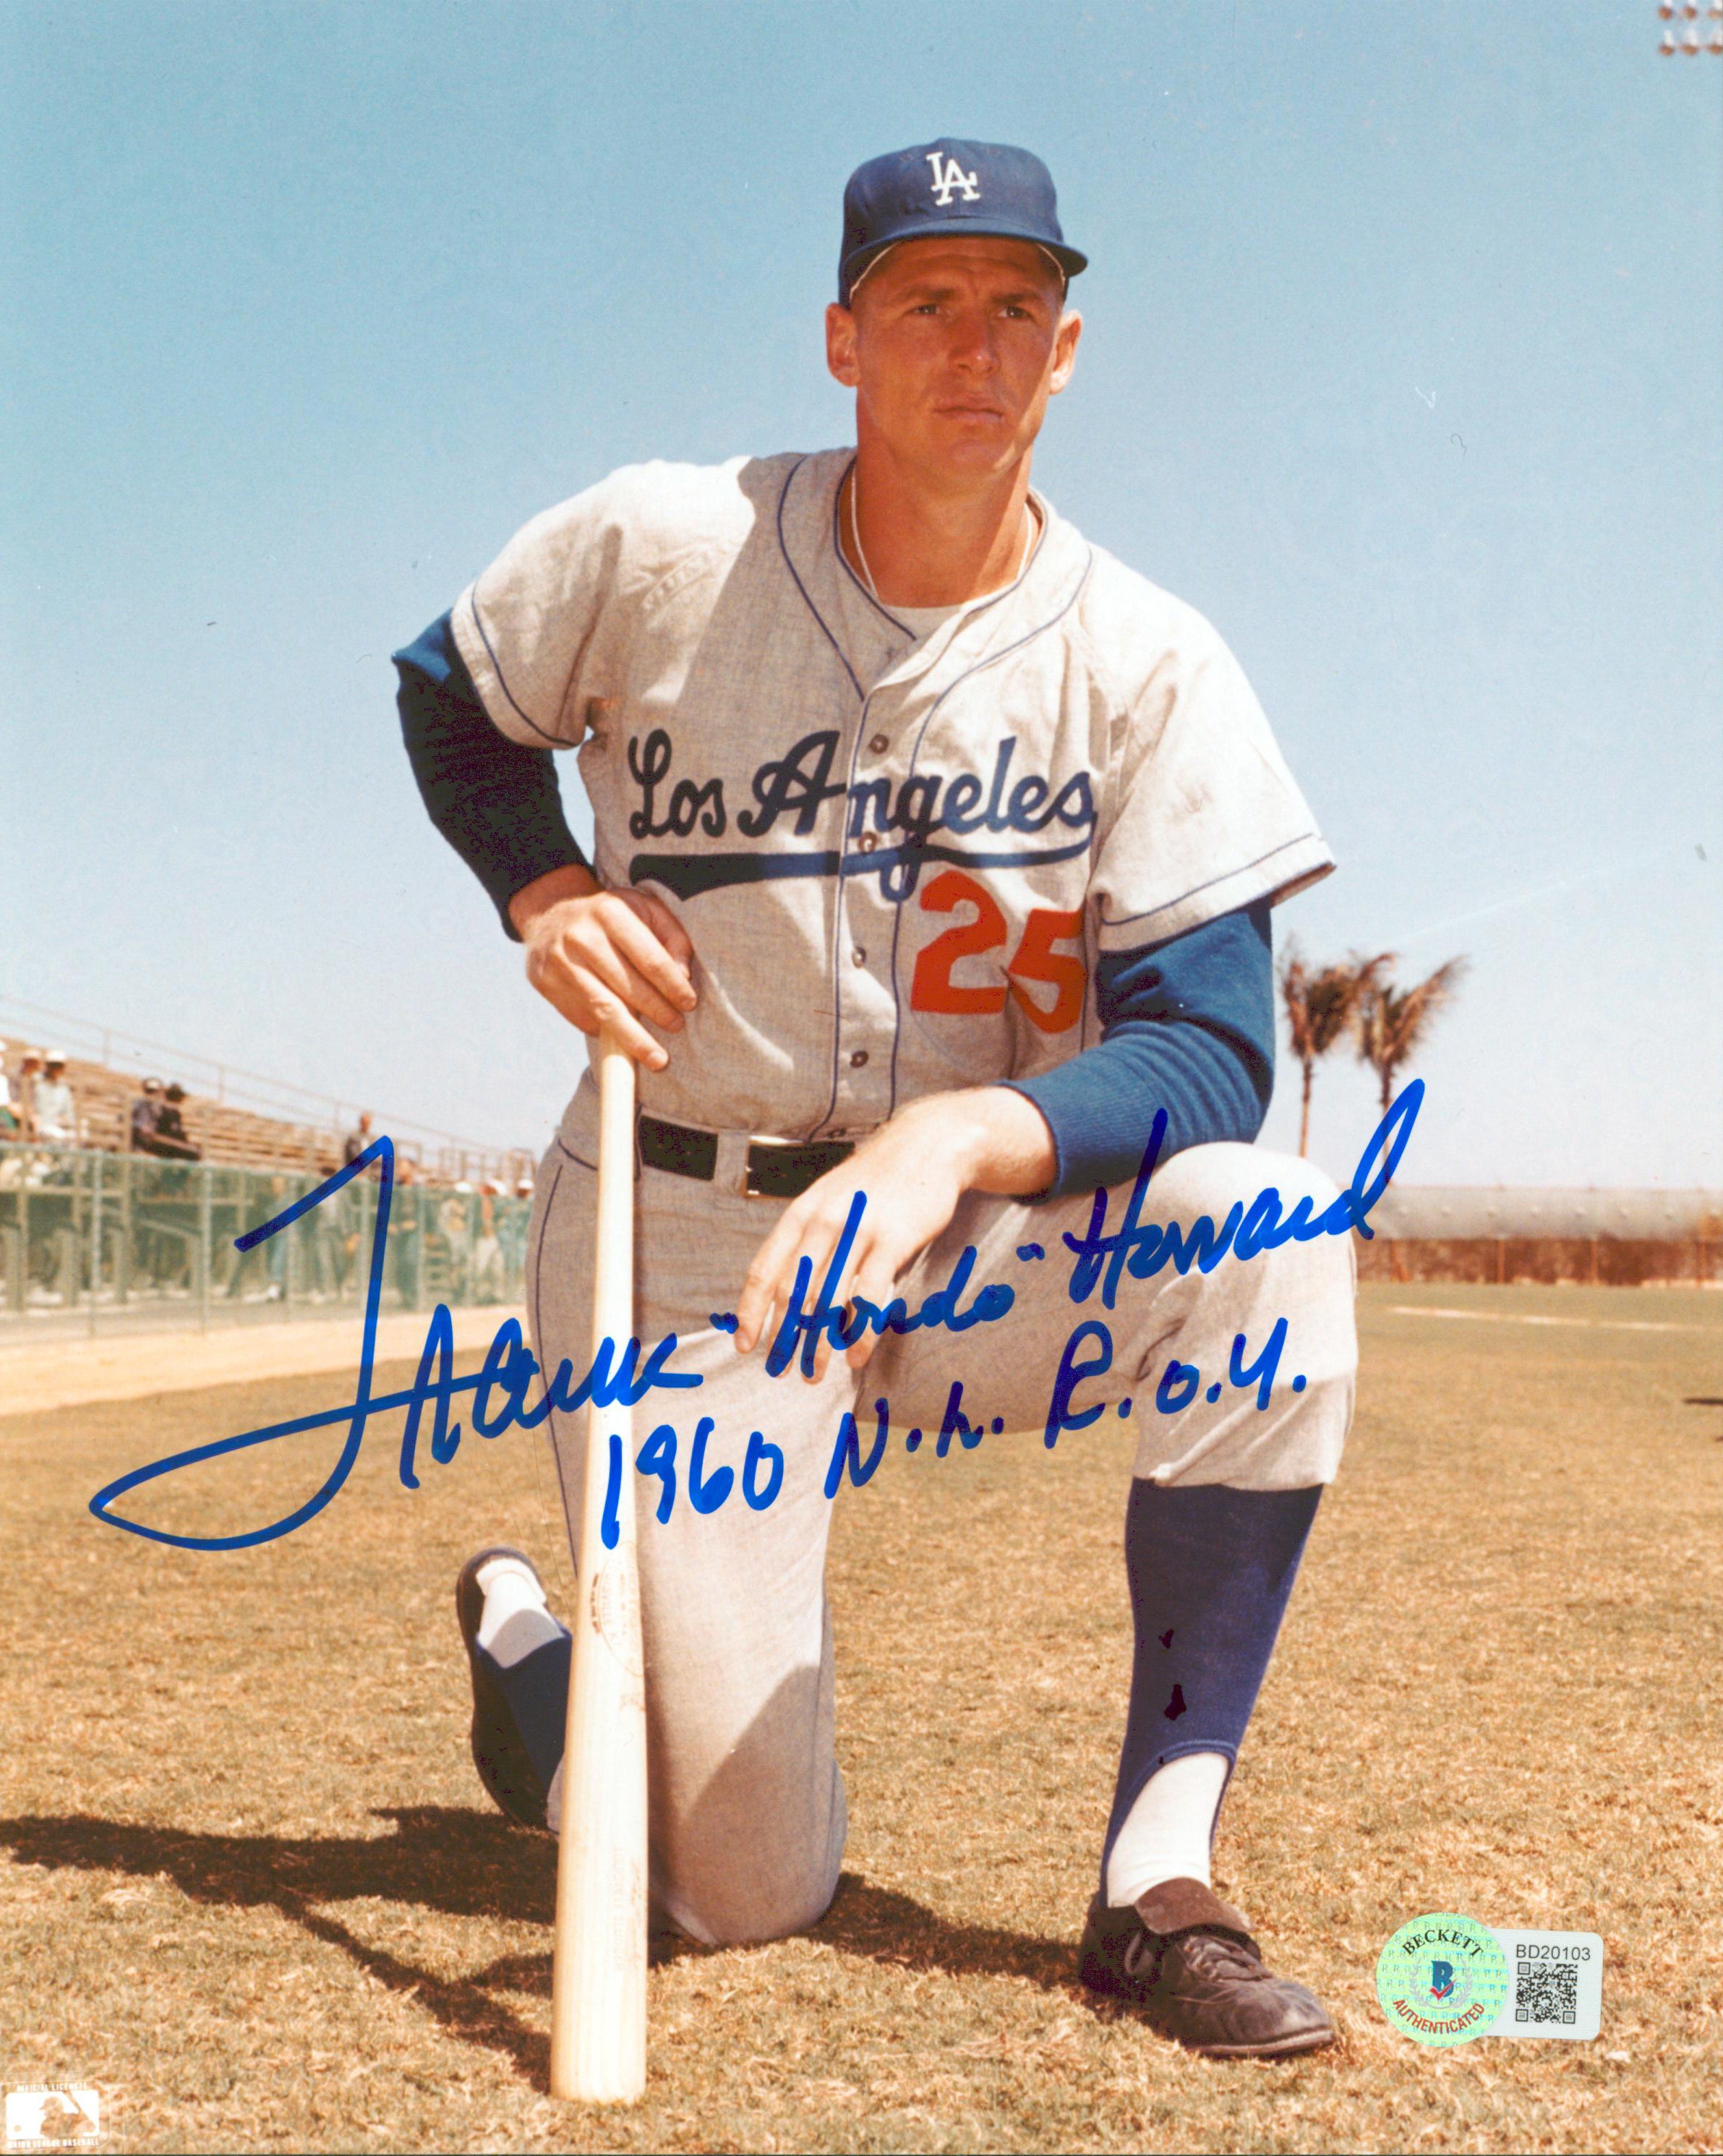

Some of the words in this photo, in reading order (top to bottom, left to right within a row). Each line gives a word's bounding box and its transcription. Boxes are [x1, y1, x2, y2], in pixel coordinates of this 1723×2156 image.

[926, 151, 980, 205] LA
[628, 728, 725, 839] Los
[736, 730, 1098, 903] Angeles
[910, 869, 1086, 1035] 25
[600, 1416, 785, 1550] 1960
[1401, 1929, 1484, 1958] BECKETT
[1515, 1943, 1591, 1962] BD20103
[1393, 1999, 1485, 2035] AUTHENTICATED
